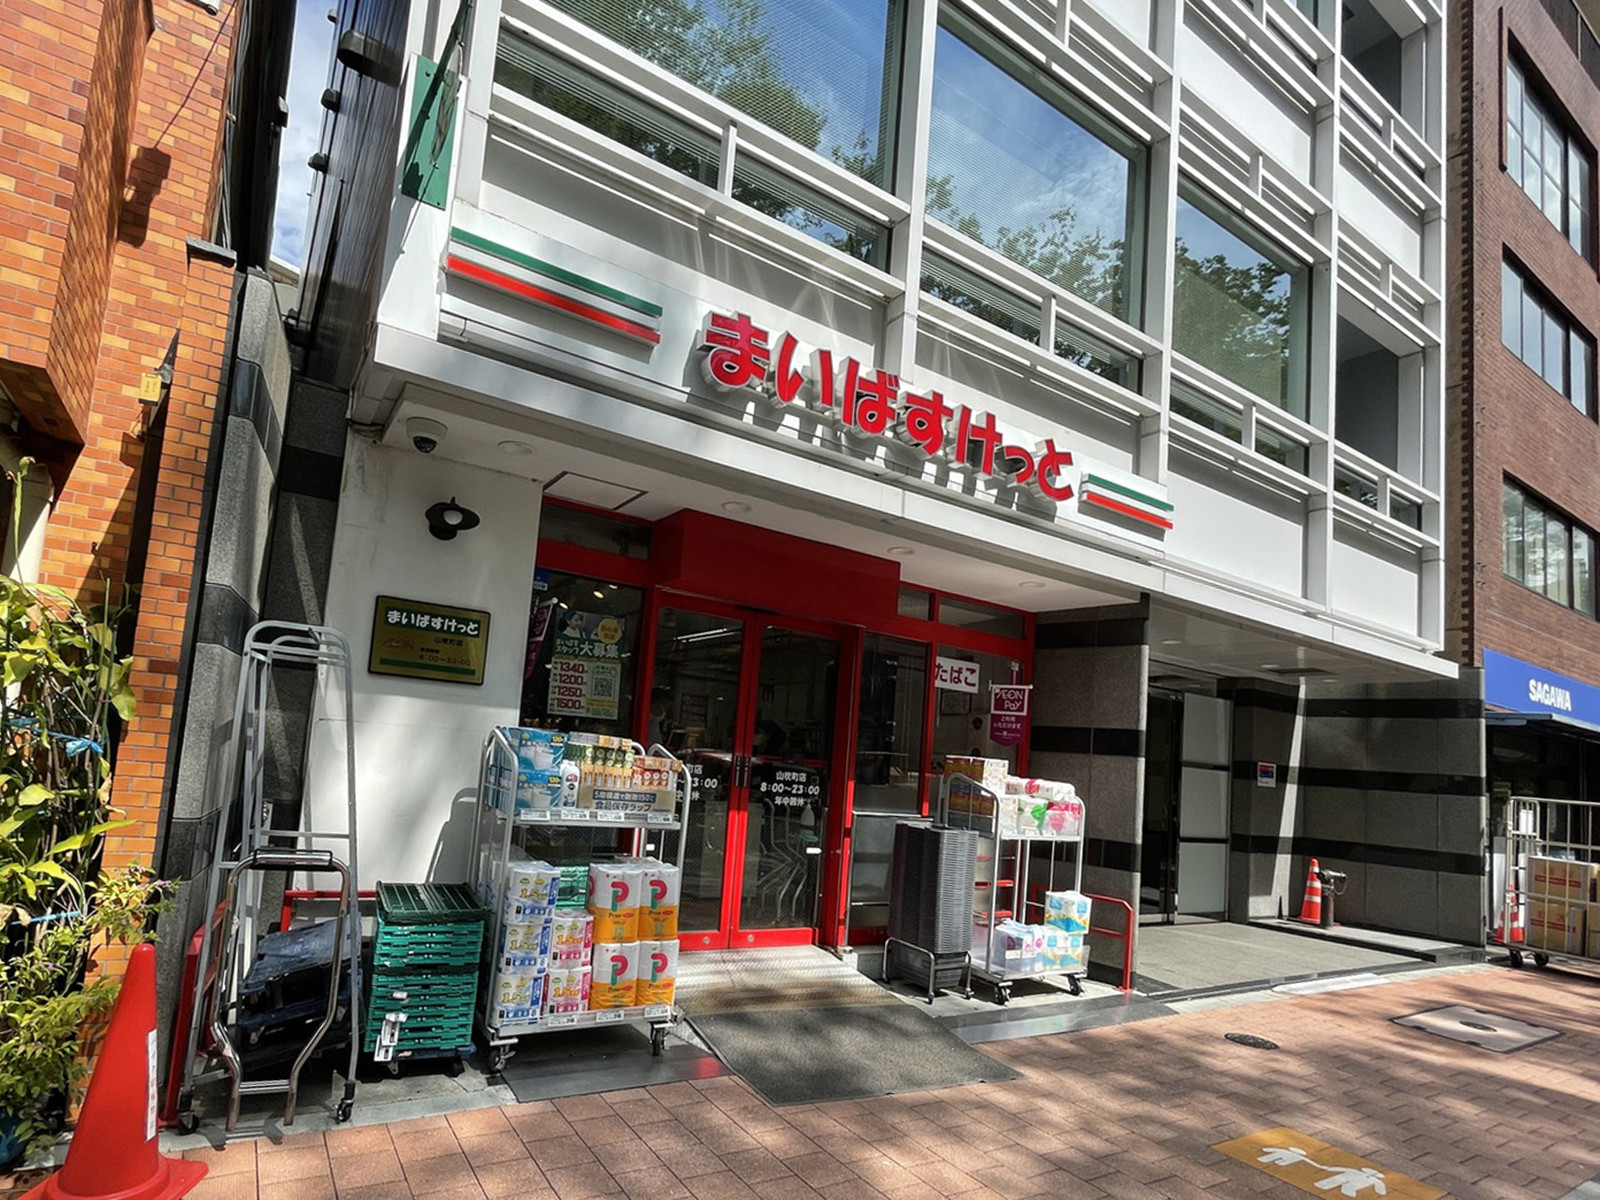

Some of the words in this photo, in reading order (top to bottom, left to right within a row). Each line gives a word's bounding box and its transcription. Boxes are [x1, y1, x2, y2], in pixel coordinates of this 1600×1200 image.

[703, 311, 1074, 501] まいばすけっと
[387, 610, 478, 635] まいばすけっと
[579, 641, 619, 659] 大募集
[936, 662, 976, 687] たばこ
[1529, 679, 1572, 711] SAGAWA
[776, 771, 807, 782] 山吹町店
[595, 801, 652, 812] 食品保存ラップ
[774, 796, 804, 807] 年中無休
